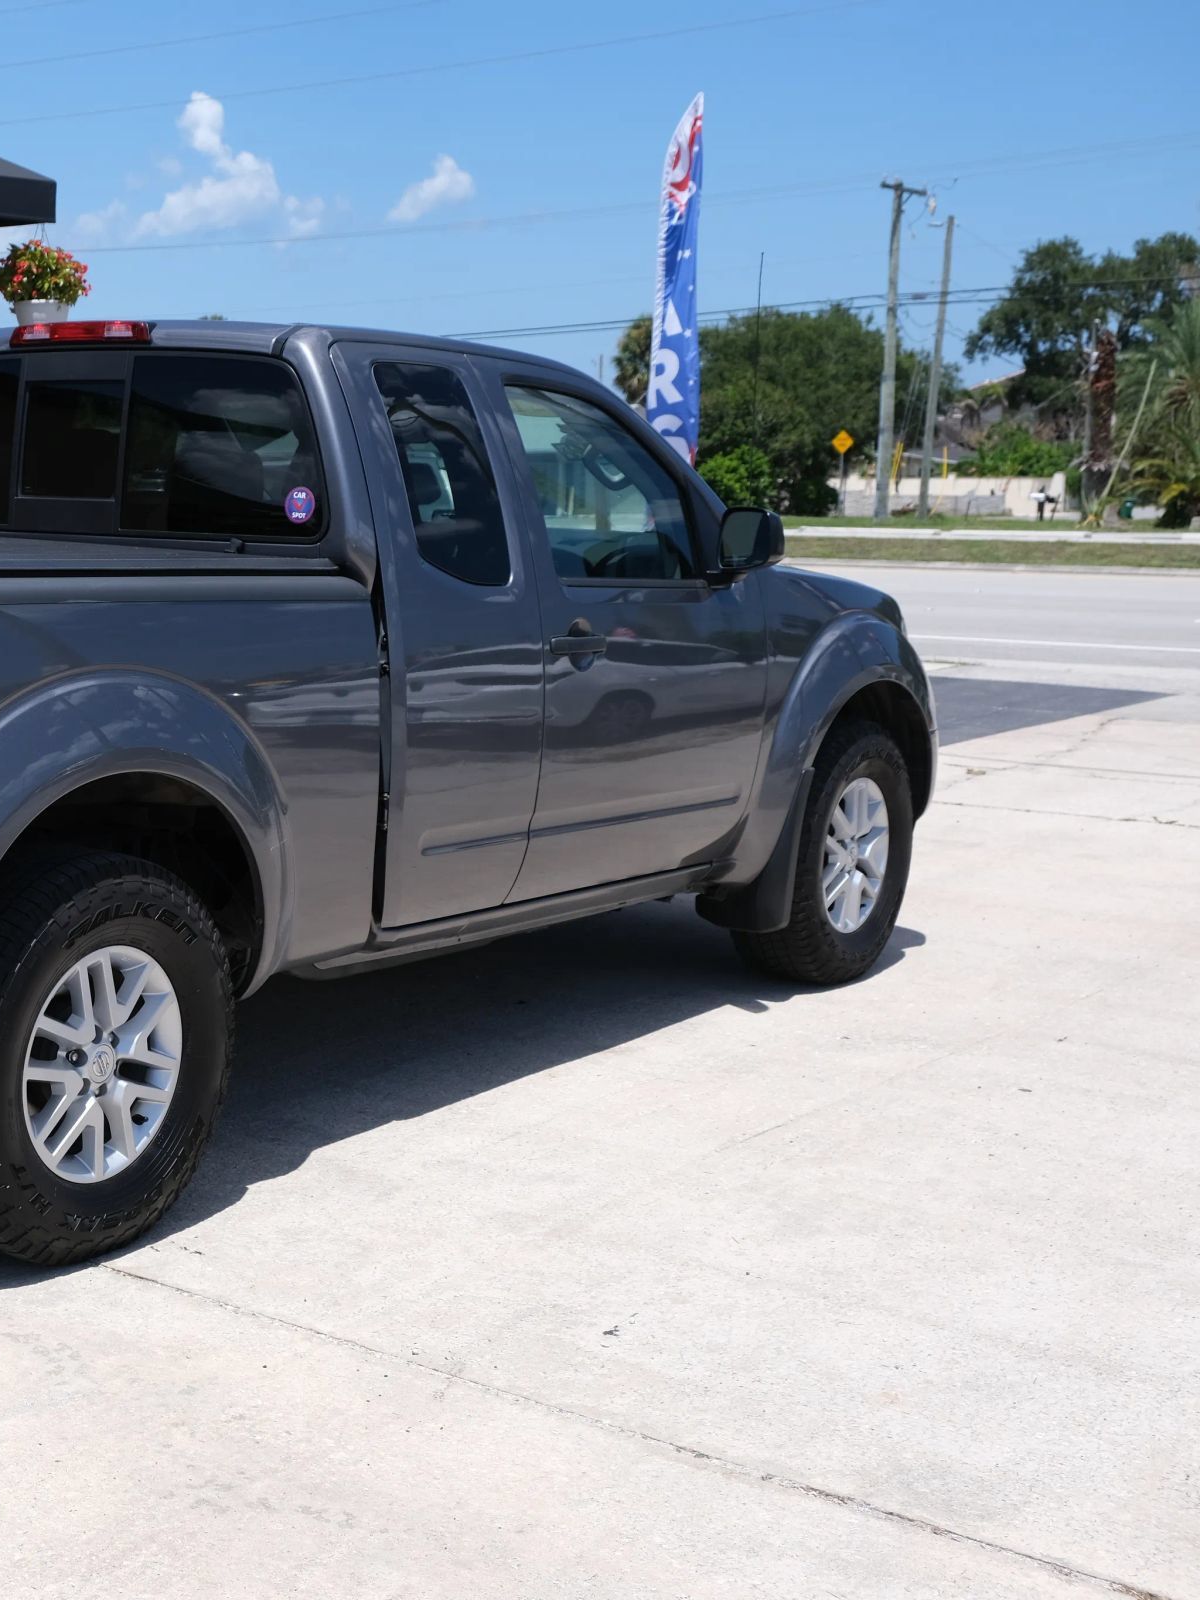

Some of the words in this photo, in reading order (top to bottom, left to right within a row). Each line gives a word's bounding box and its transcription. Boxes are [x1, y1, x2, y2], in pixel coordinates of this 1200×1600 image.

[293, 491, 307, 499] CAR
[292, 511, 307, 519] SPOT
[63, 901, 198, 947] FALKEN
